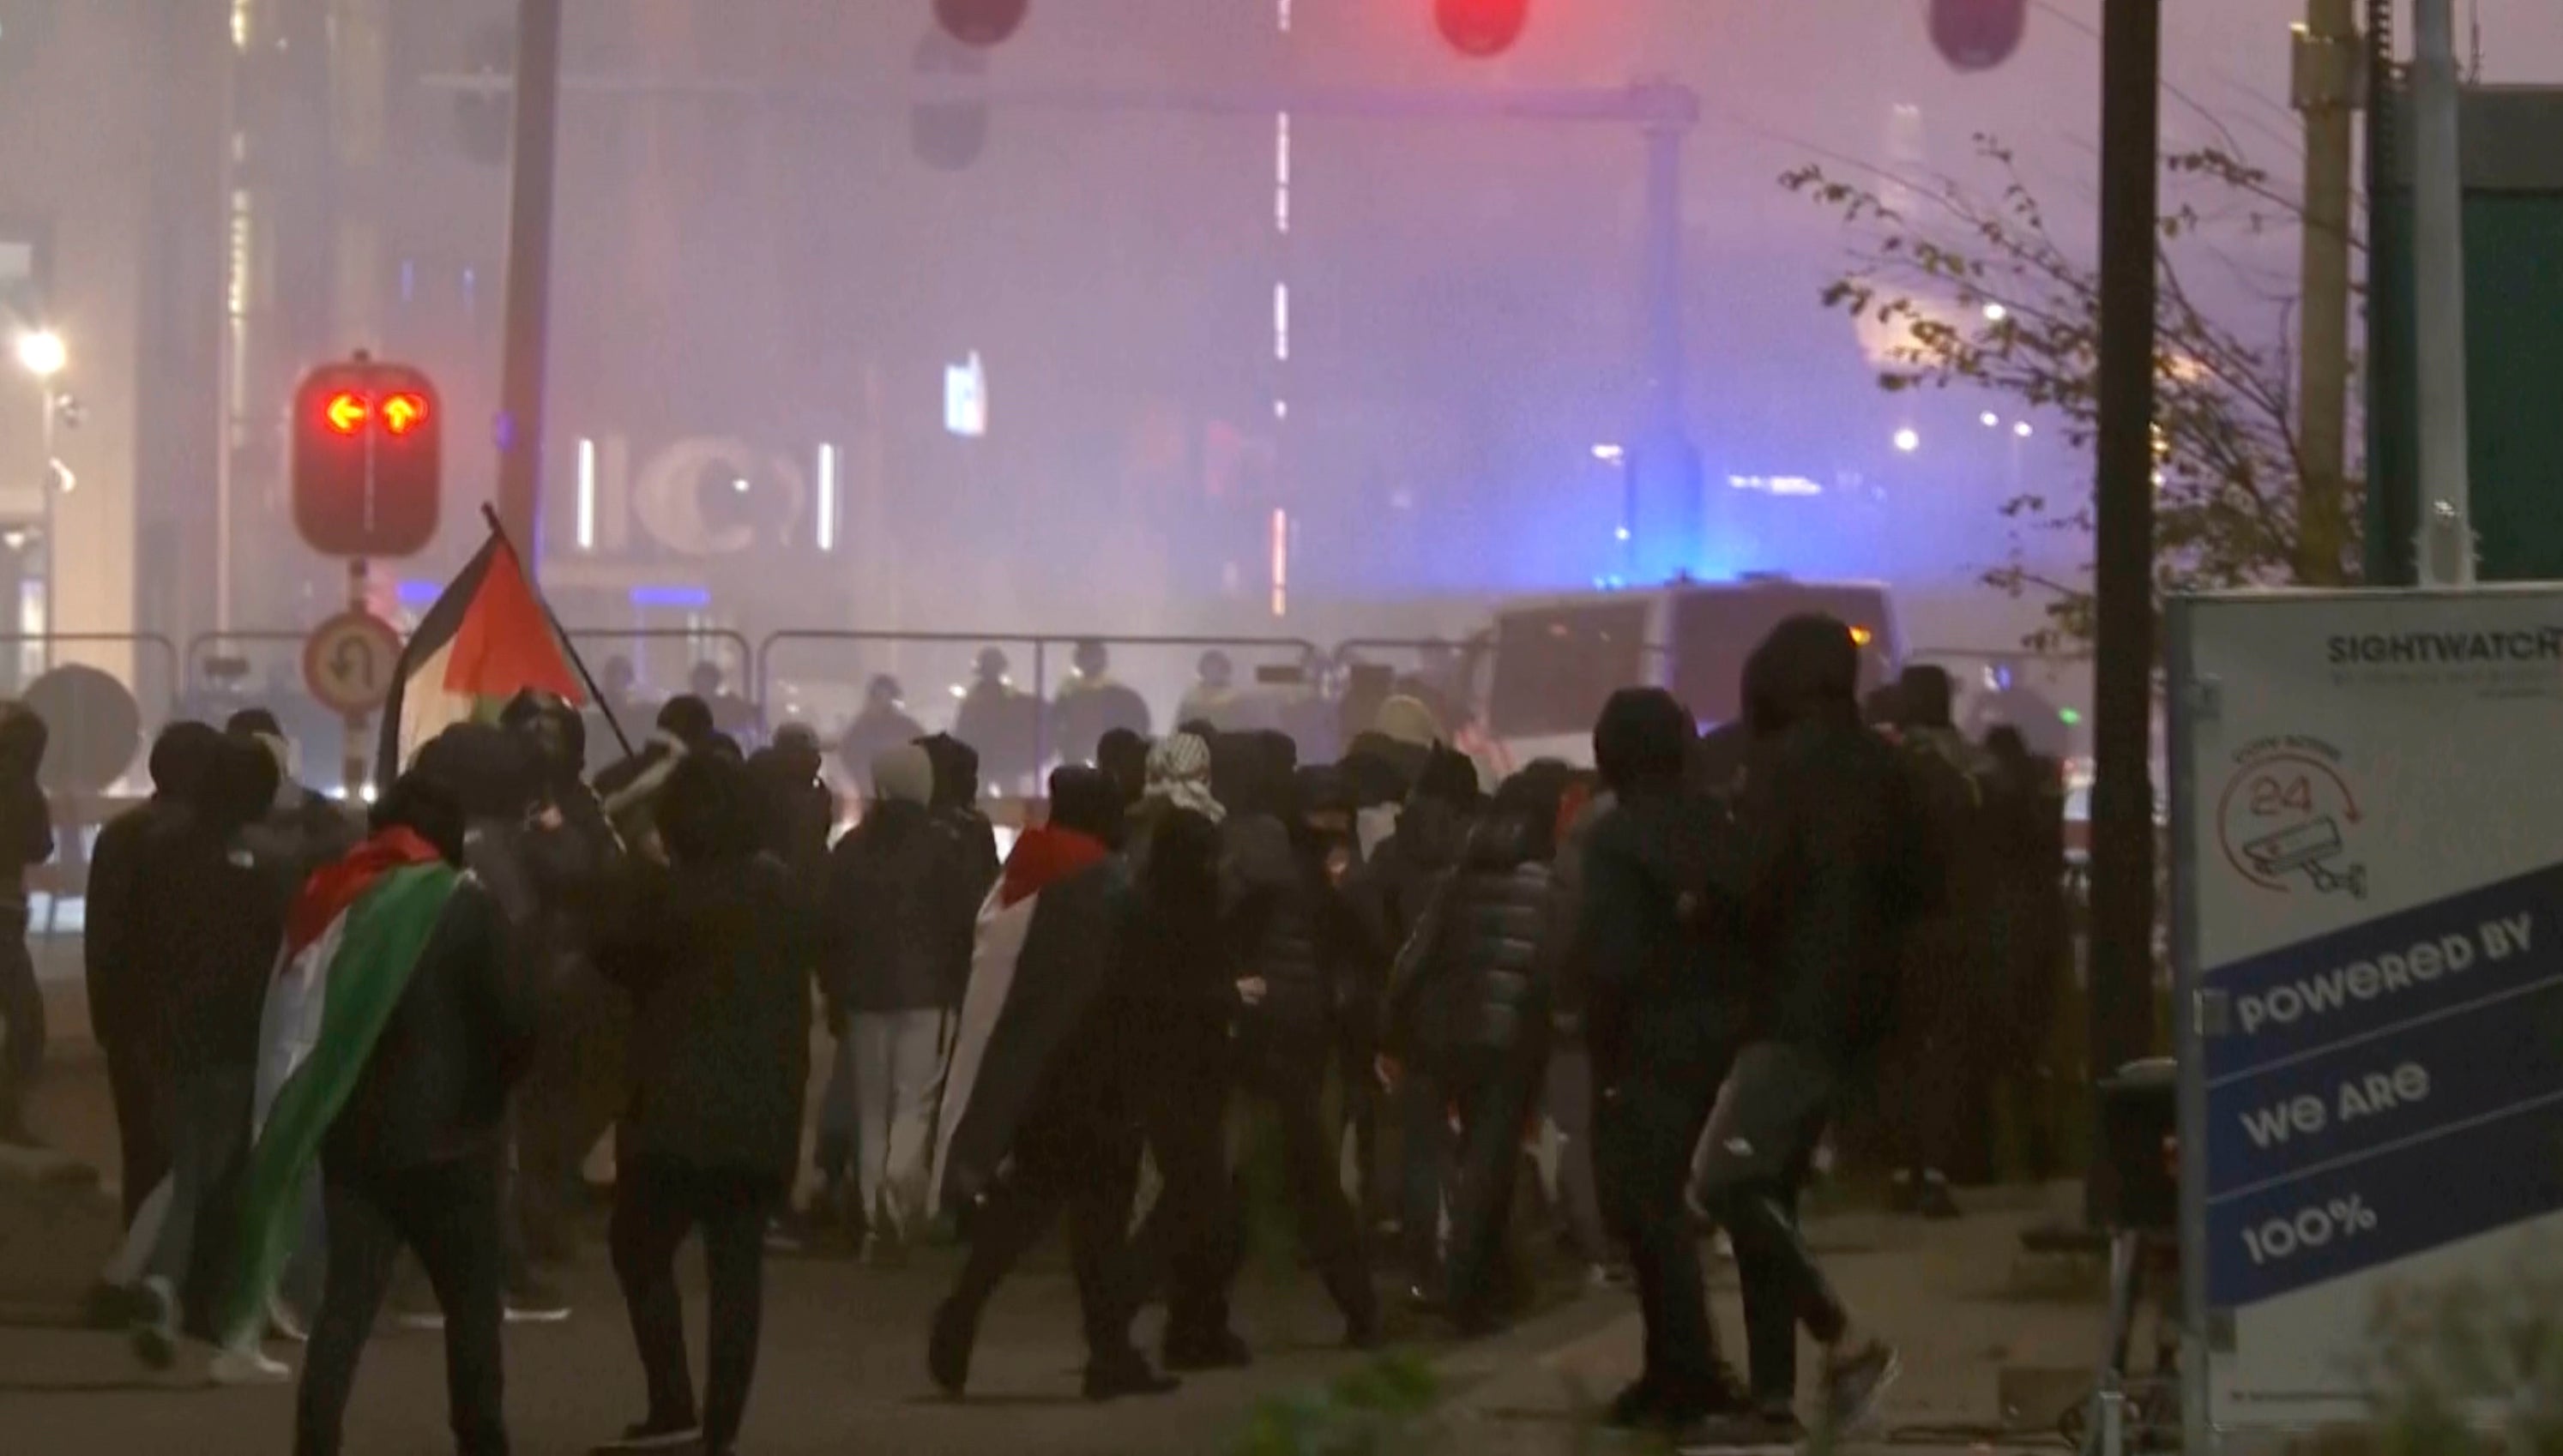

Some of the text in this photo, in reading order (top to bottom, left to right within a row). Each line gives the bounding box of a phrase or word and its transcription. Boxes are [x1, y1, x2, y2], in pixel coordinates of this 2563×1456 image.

[2251, 777, 2313, 815] 24
[2481, 912, 2533, 961] BY
[2242, 1194, 2378, 1266] 100%
